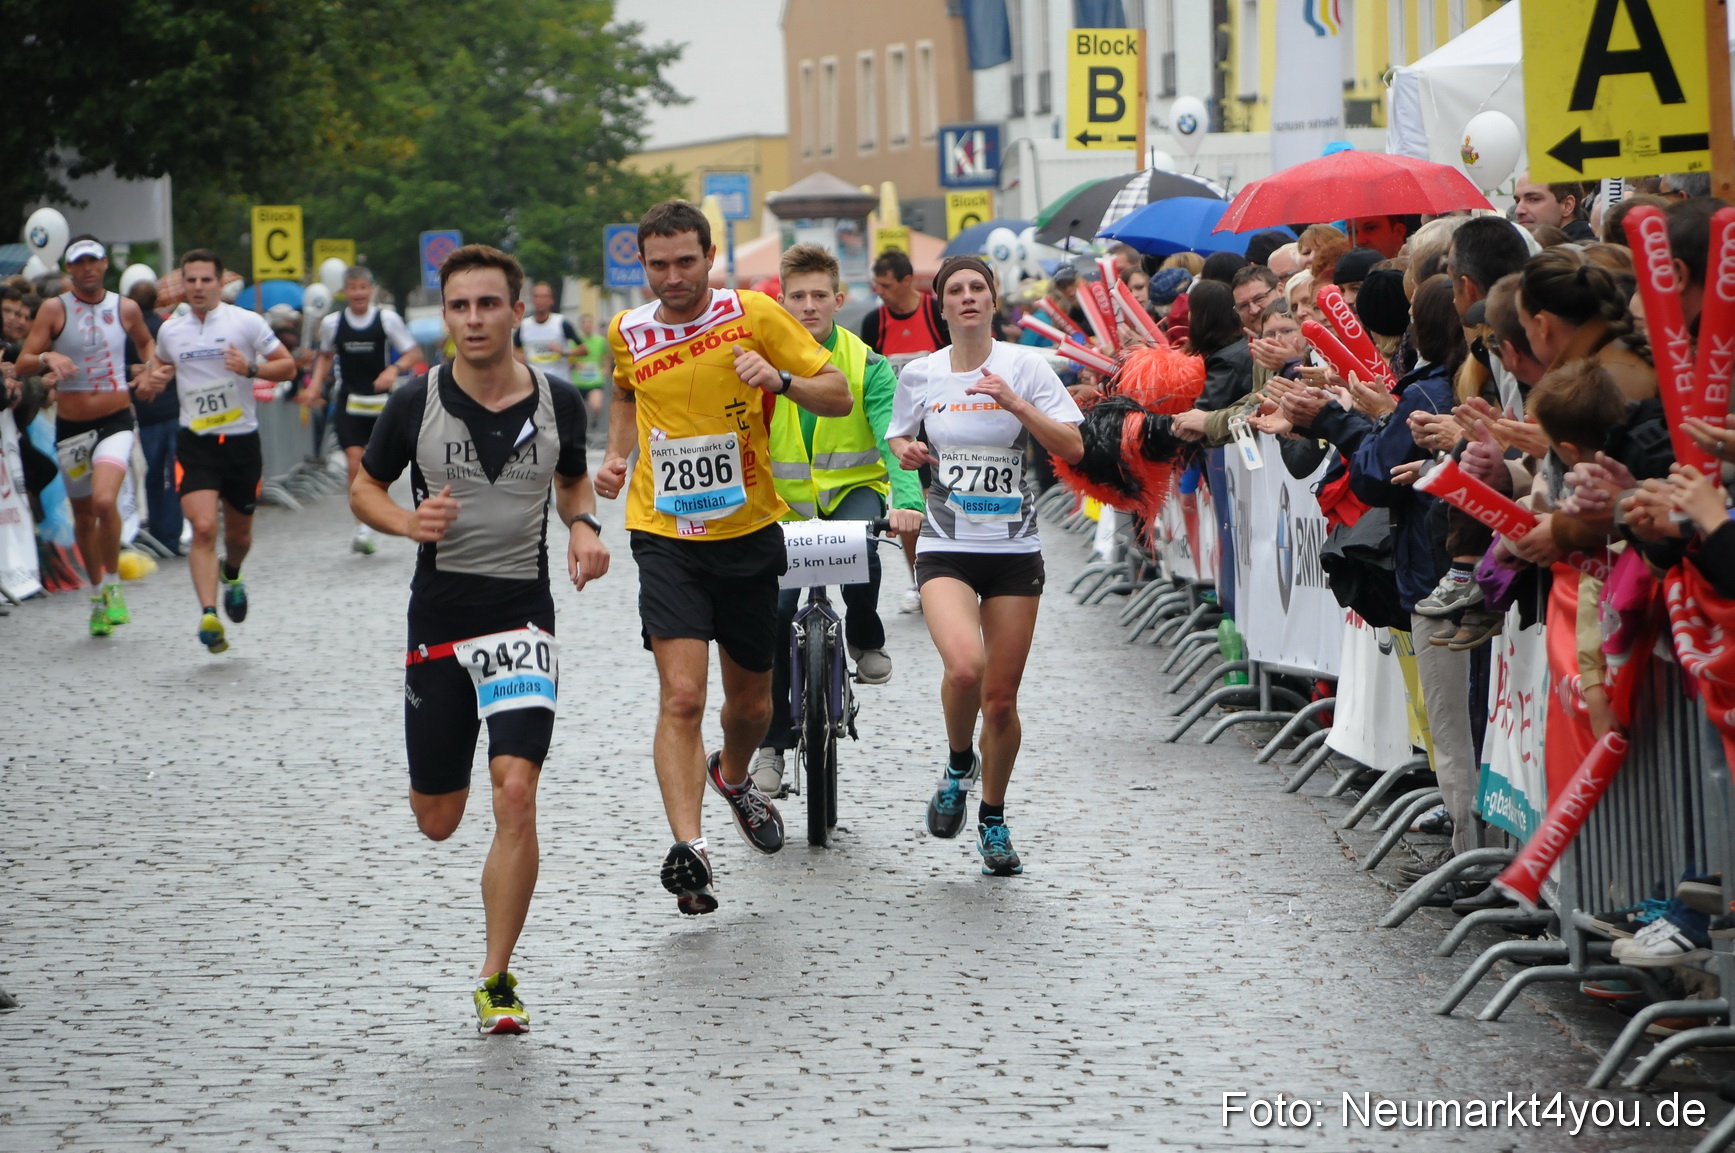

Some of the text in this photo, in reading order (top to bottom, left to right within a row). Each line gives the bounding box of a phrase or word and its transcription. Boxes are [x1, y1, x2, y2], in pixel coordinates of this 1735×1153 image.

[1077, 34, 1138, 55] Block
[1568, 0, 1686, 112] A
[1088, 66, 1126, 123] B
[266, 228, 289, 262] C
[634, 325, 752, 384] MAX BÖGL
[196, 393, 229, 414] 261
[651, 442, 722, 458] PARTL Neumarkt
[941, 453, 1010, 463] PARTL Neumarkt
[661, 454, 733, 491] 2896
[674, 495, 727, 512] Christian
[1444, 486, 1508, 528] Audi
[817, 534, 846, 545] Frau
[788, 554, 857, 570] ,5 km Lauf
[472, 640, 551, 677] 2420
[493, 681, 541, 699] Andreas
